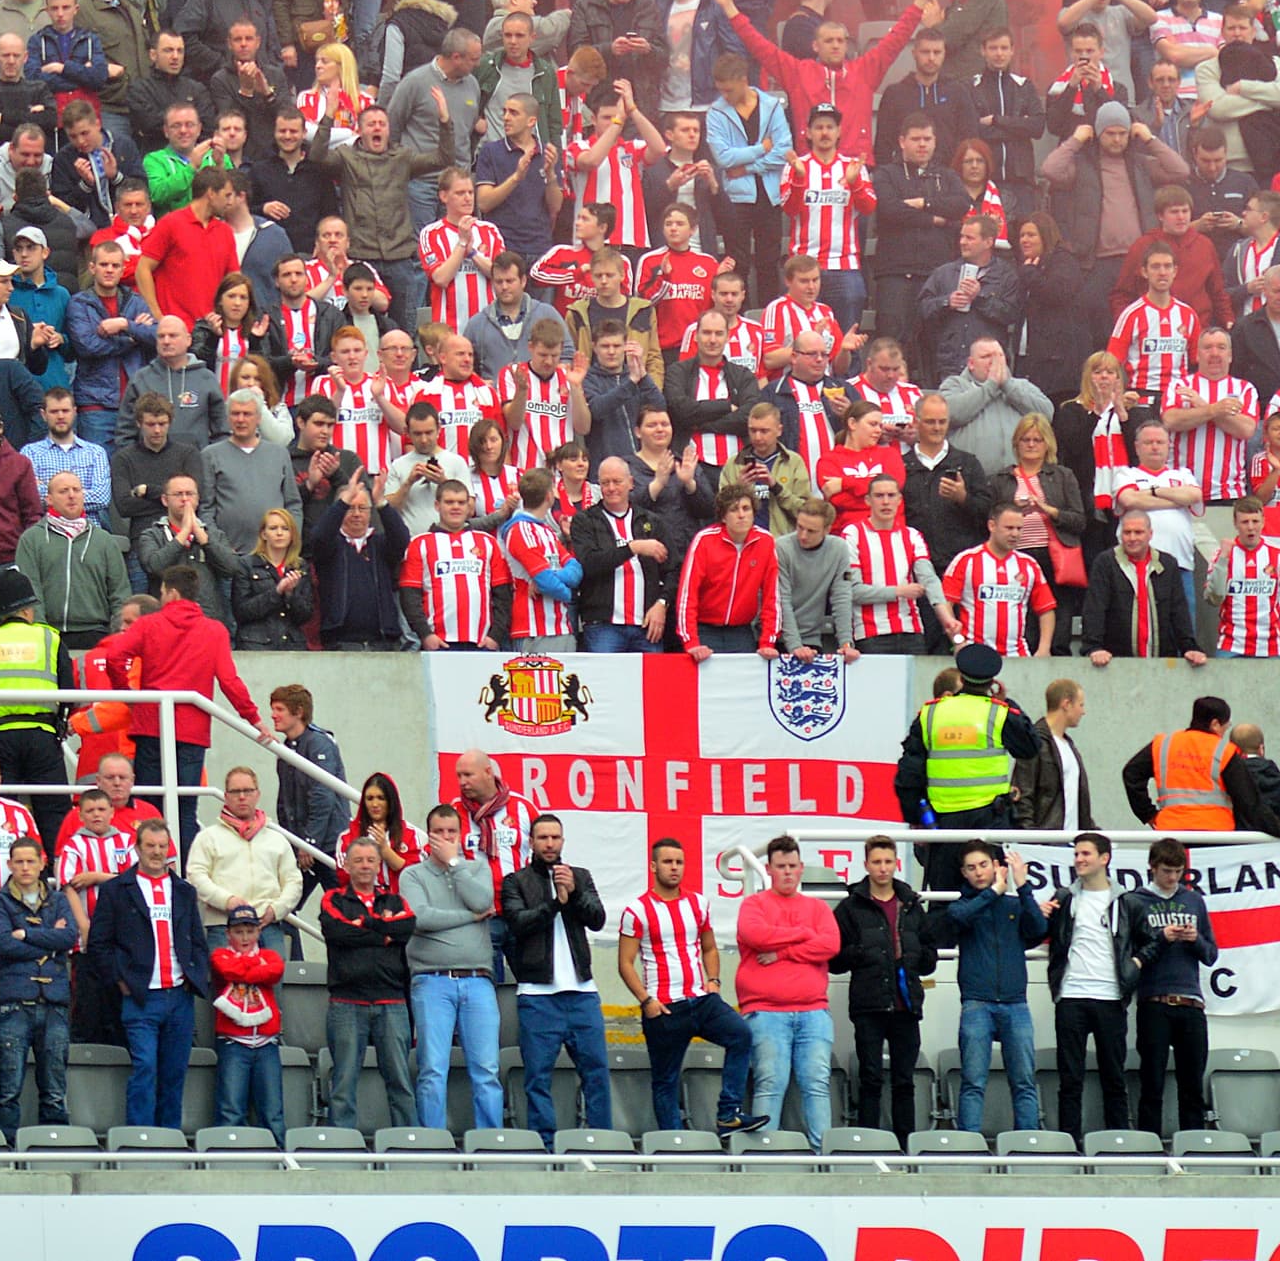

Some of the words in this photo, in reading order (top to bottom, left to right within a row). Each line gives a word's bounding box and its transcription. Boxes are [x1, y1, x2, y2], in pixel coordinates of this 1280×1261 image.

[819, 195, 848, 204] AFRICA
[1157, 344, 1186, 353] AFRICA
[352, 412, 382, 422] AFRICA
[450, 565, 480, 574] AFRICA
[1243, 585, 1273, 595] AFRICA
[994, 591, 1022, 601] AFRICA
